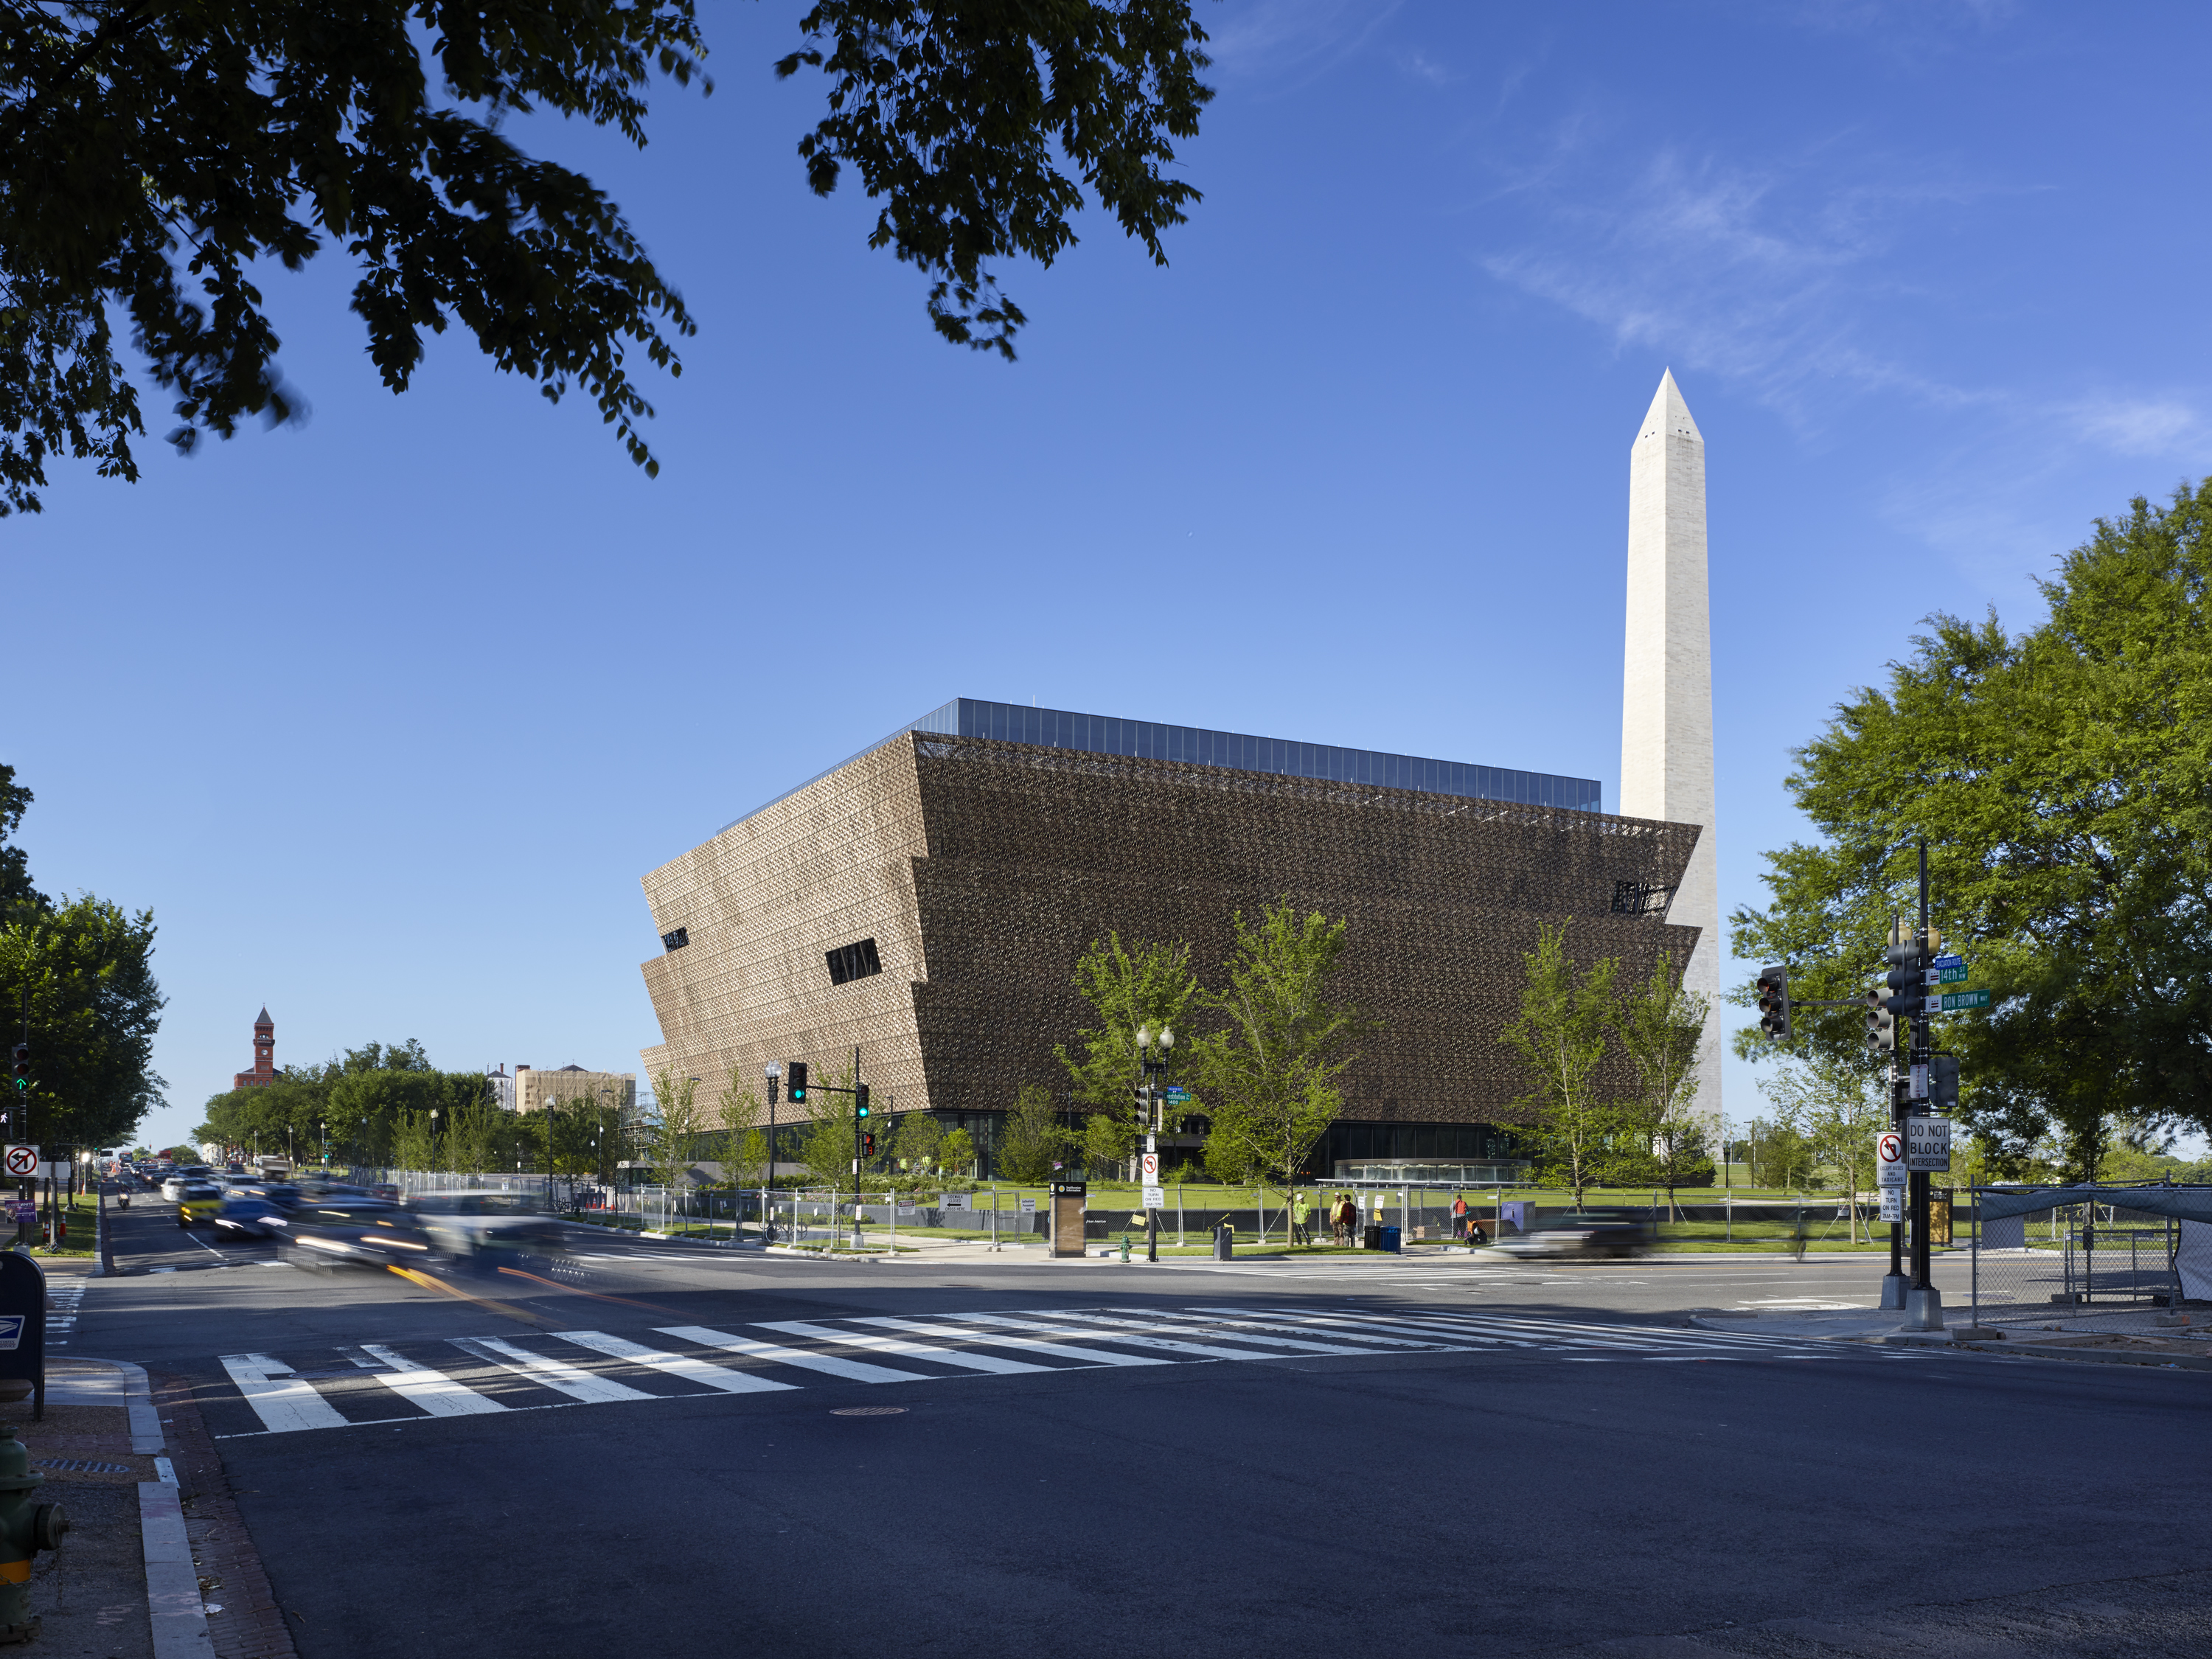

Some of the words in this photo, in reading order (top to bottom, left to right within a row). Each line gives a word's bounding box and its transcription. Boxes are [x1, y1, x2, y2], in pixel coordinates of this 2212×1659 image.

[1937, 959, 1952, 968] EVACUATION
[1952, 957, 1961, 966] ROUTE
[1941, 968, 1957, 981] 14th
[1944, 996, 1955, 1008] RON
[1958, 993, 1978, 1007] BROWN
[1910, 1125, 1924, 1137] DO
[1928, 1125, 1948, 1137] NOT
[869, 1146, 873, 1155] 9
[1910, 1142, 1947, 1154] BLOCK
[1910, 1158, 1948, 1167] INTERSECTION
